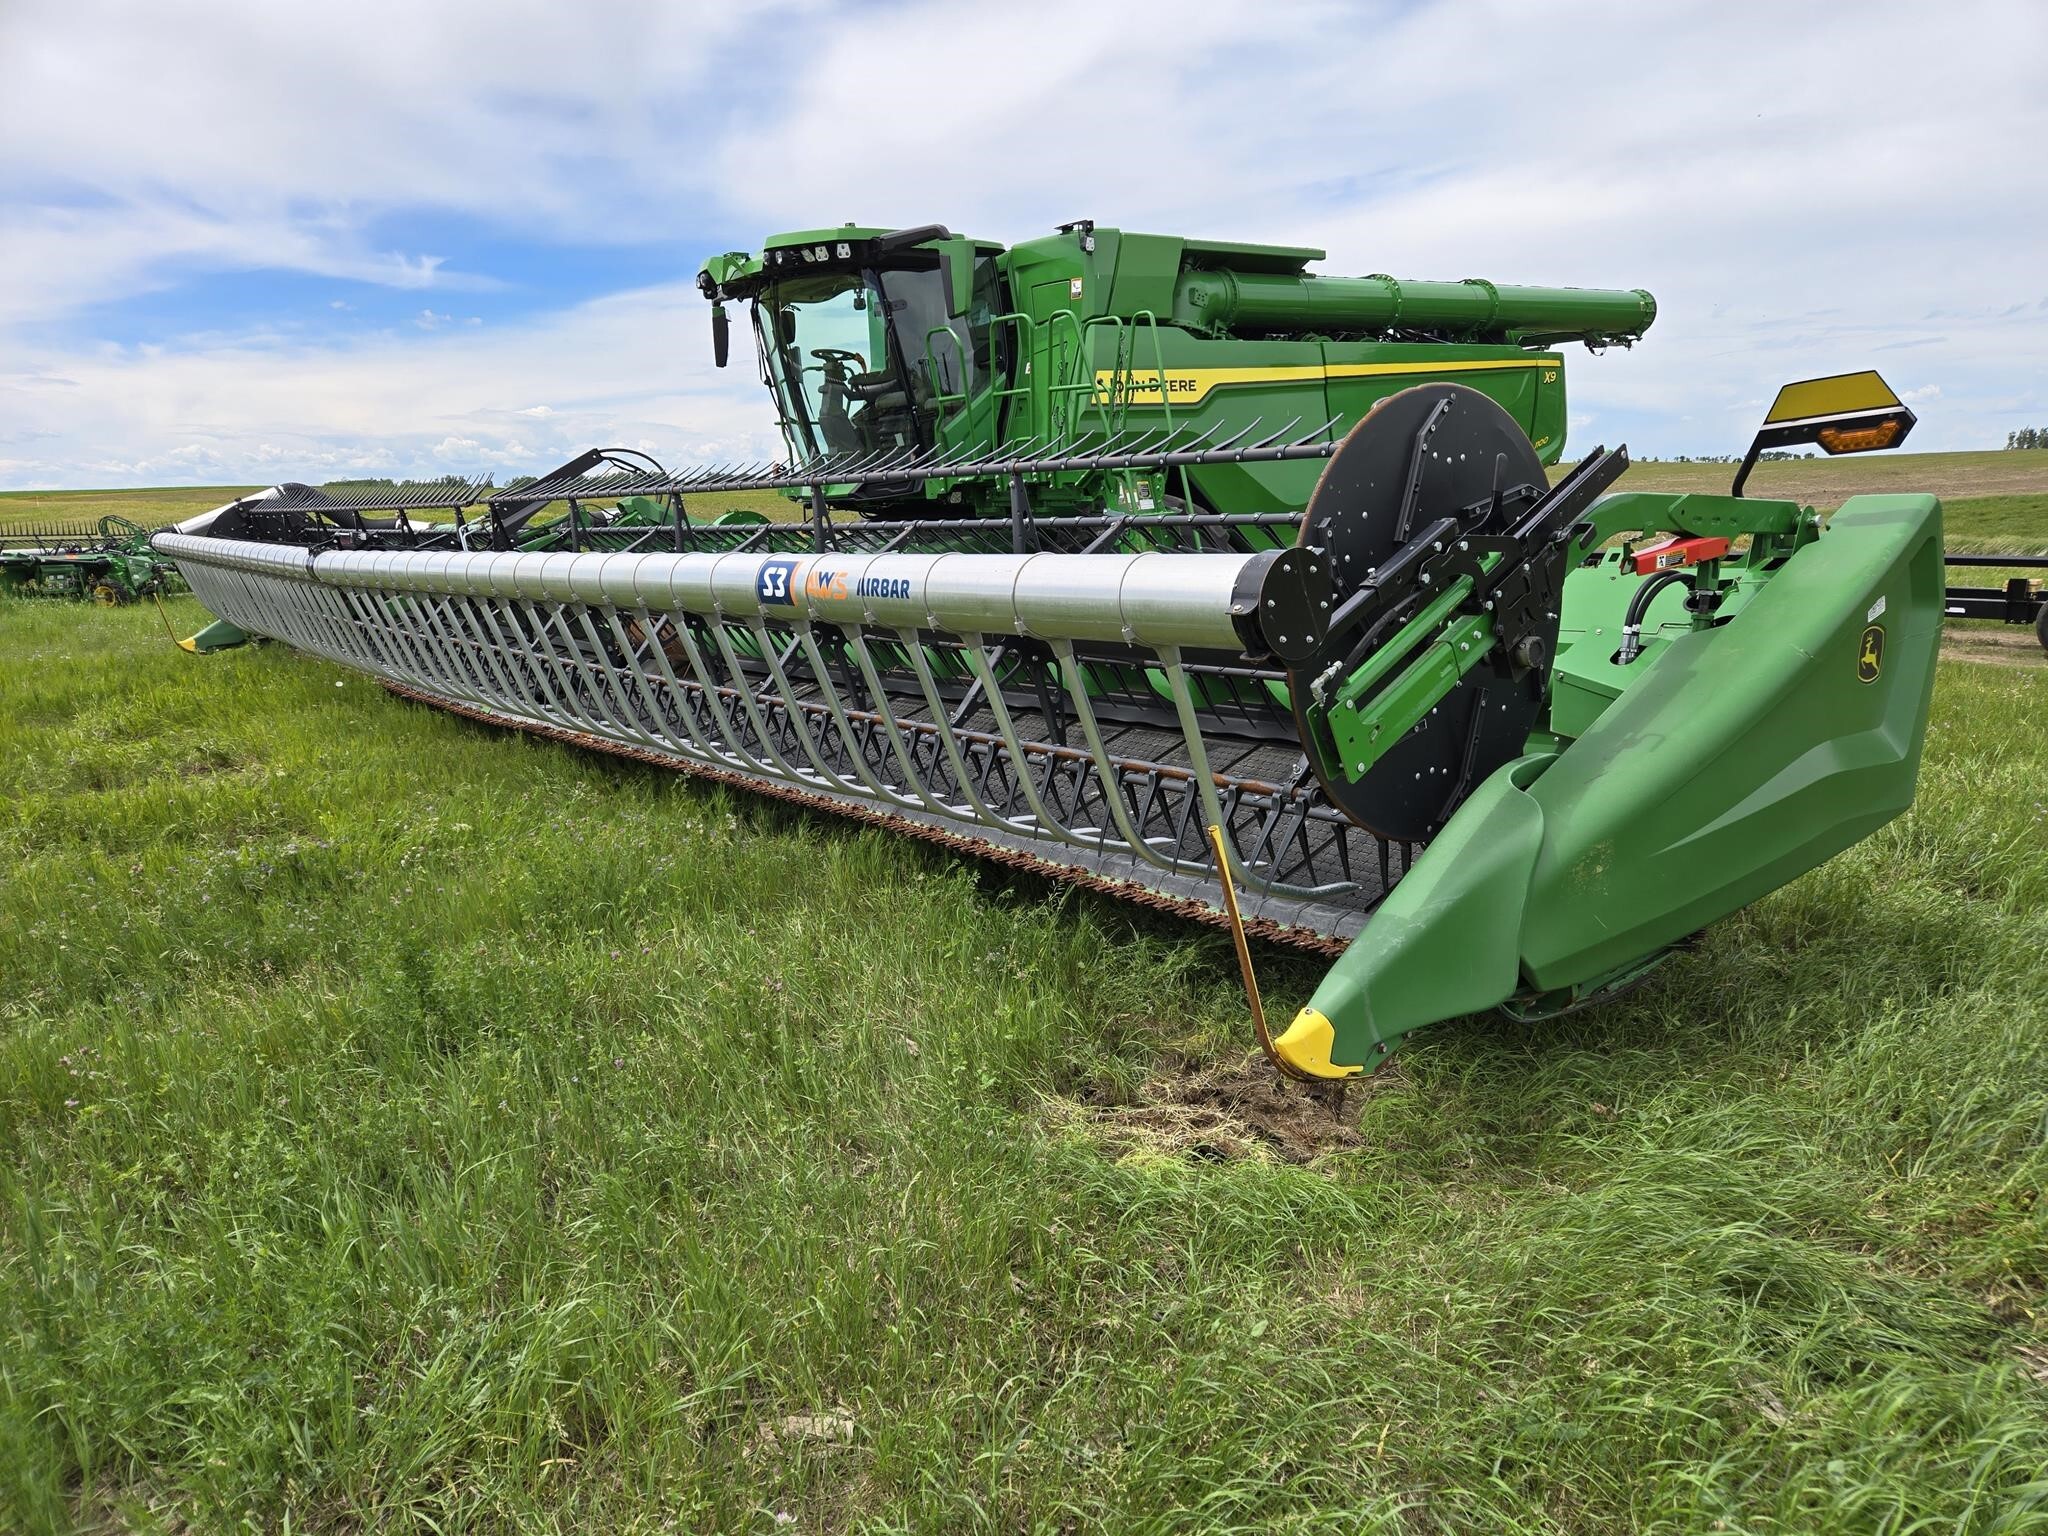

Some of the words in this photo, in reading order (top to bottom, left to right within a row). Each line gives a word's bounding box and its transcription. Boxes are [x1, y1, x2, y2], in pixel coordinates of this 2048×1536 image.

[1543, 371, 1557, 384] X9
[1109, 378, 1145, 393] ON
[762, 566, 788, 598] S3
[806, 571, 849, 600] AWS
[856, 577, 911, 600] AIRBAR
